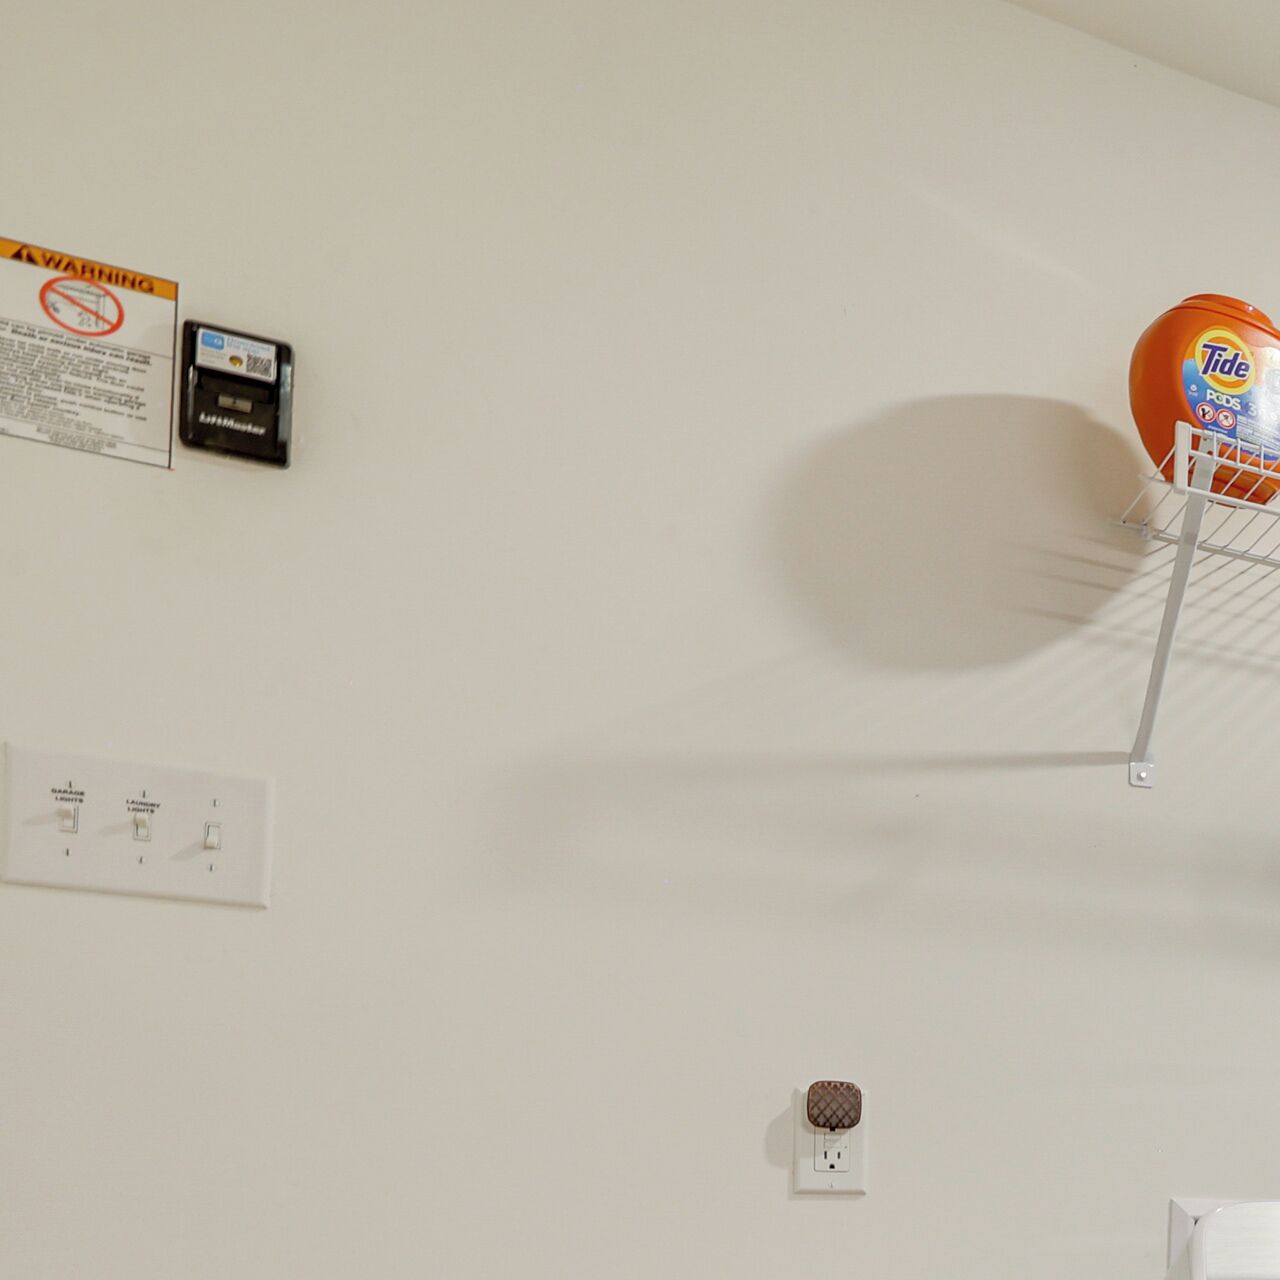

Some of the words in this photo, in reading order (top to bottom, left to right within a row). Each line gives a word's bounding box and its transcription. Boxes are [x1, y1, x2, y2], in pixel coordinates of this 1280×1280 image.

[42, 252, 154, 294] WARNING
[1201, 343, 1250, 378] Tide
[1206, 389, 1241, 411] PODS
[51, 788, 85, 797] GARAGE
[55, 796, 84, 804] LIGHTS
[127, 806, 155, 814] LIGHTS
